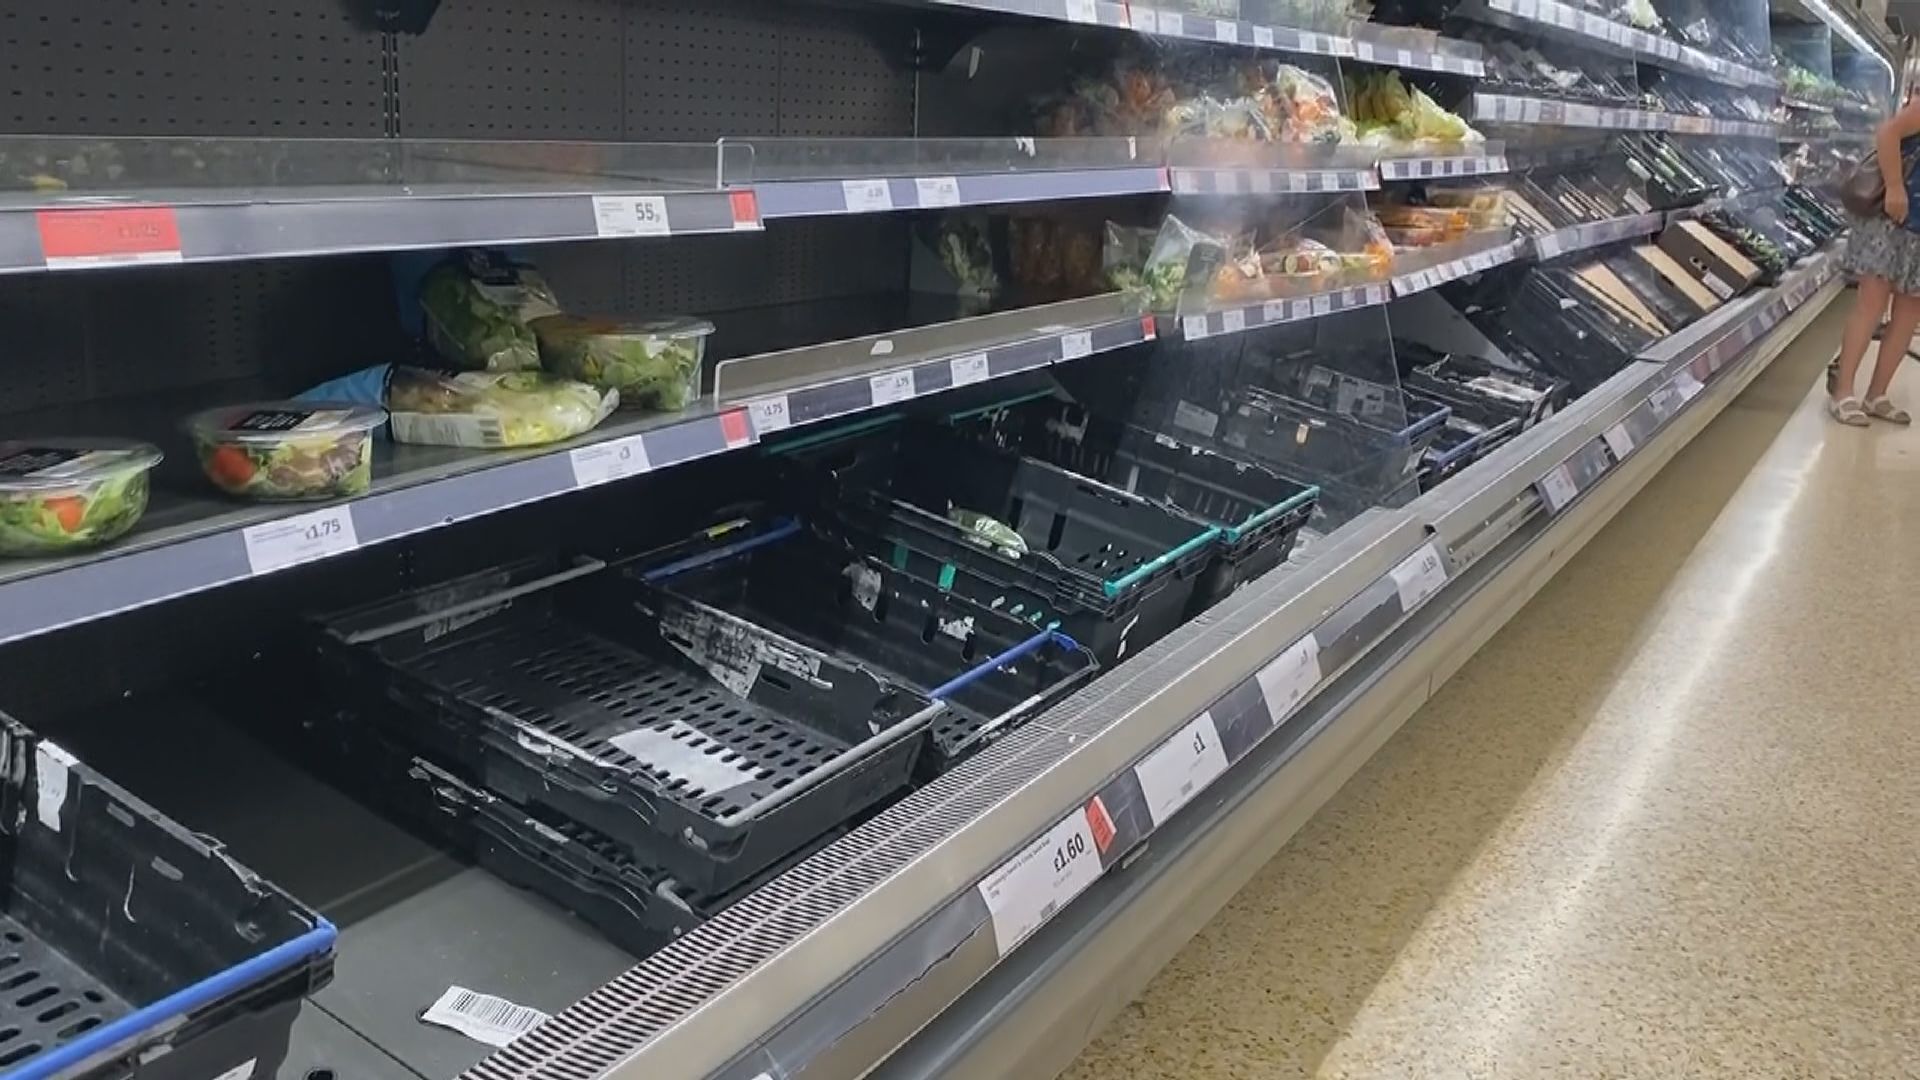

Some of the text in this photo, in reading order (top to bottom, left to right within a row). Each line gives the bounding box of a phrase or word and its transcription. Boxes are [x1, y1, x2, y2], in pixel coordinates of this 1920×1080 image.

[635, 203, 661, 223] 55p
[304, 518, 341, 540] £1.75
[1193, 731, 1206, 755] £1
[1052, 832, 1085, 872] £1.60
